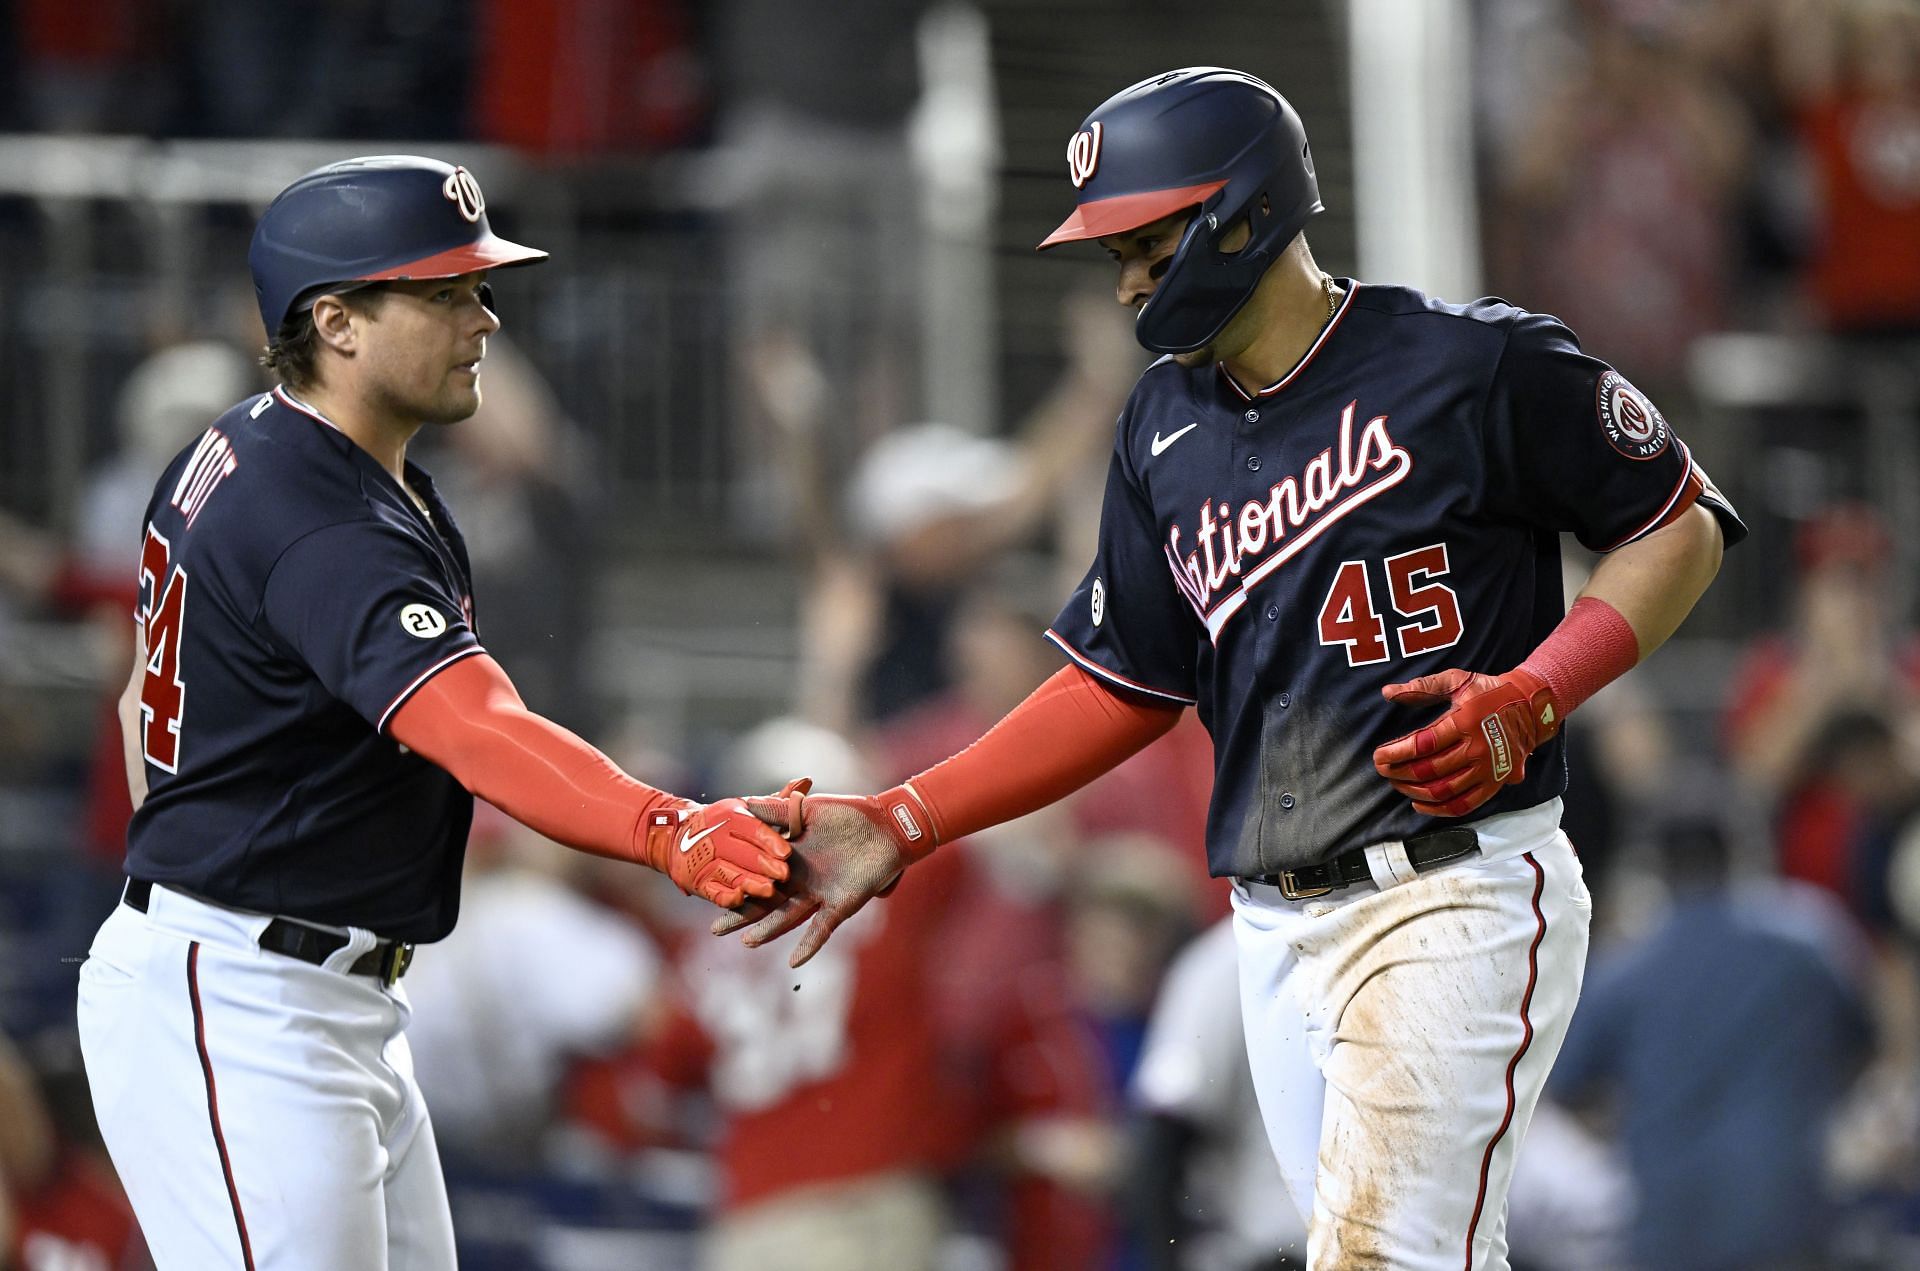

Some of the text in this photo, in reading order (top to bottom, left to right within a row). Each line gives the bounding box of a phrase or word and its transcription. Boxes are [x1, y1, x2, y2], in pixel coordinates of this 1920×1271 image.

[1639, 399, 1666, 455] NATIONA
[1164, 399, 1413, 648] Nationals
[408, 610, 439, 632] 21
[1317, 543, 1464, 668] 45
